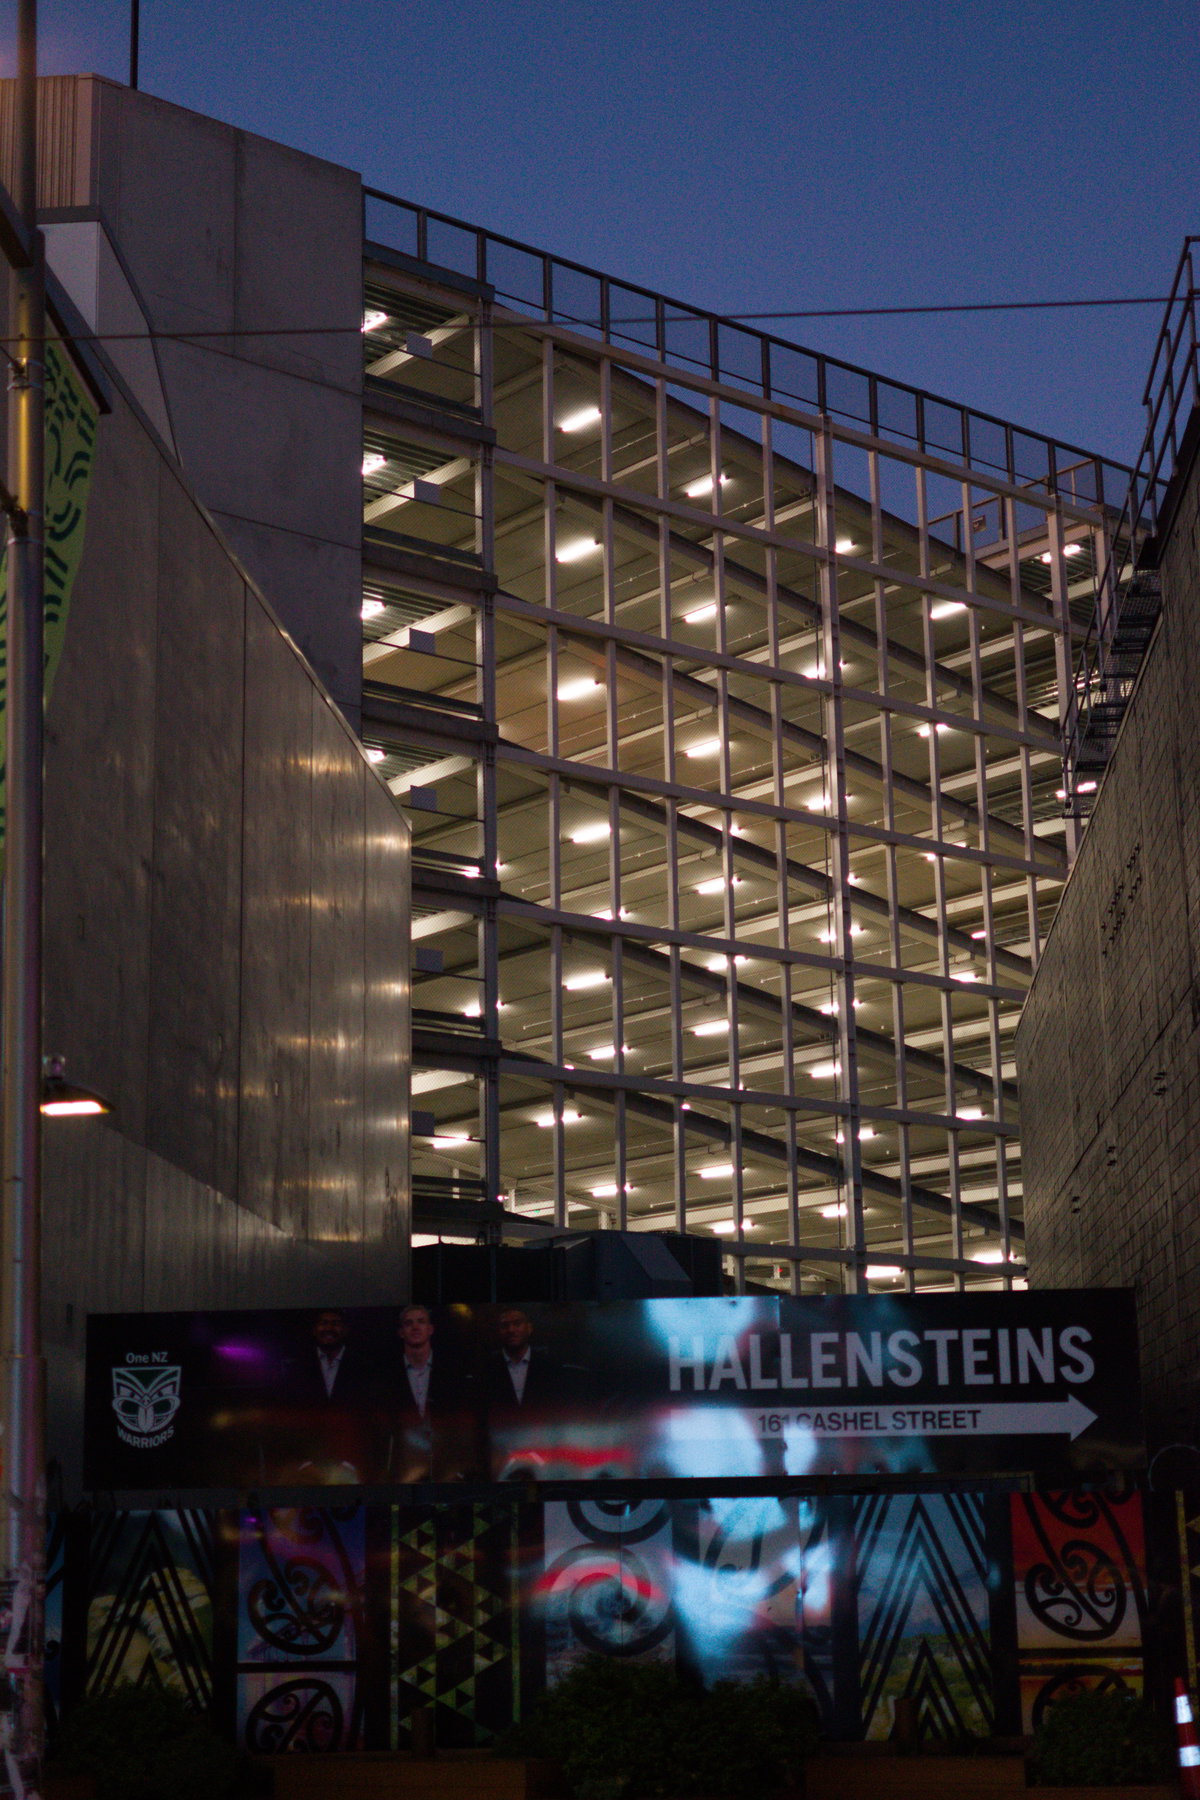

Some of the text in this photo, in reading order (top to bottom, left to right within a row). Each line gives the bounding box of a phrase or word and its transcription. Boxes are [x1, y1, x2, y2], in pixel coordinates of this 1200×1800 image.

[126, 1351, 168, 1364] One NZ
[668, 1325, 1096, 1391] HALLENSTEINS
[795, 1411, 888, 1432] CASHEL
[891, 1409, 981, 1429] STREET
[116, 1425, 175, 1448] WARRIORS
